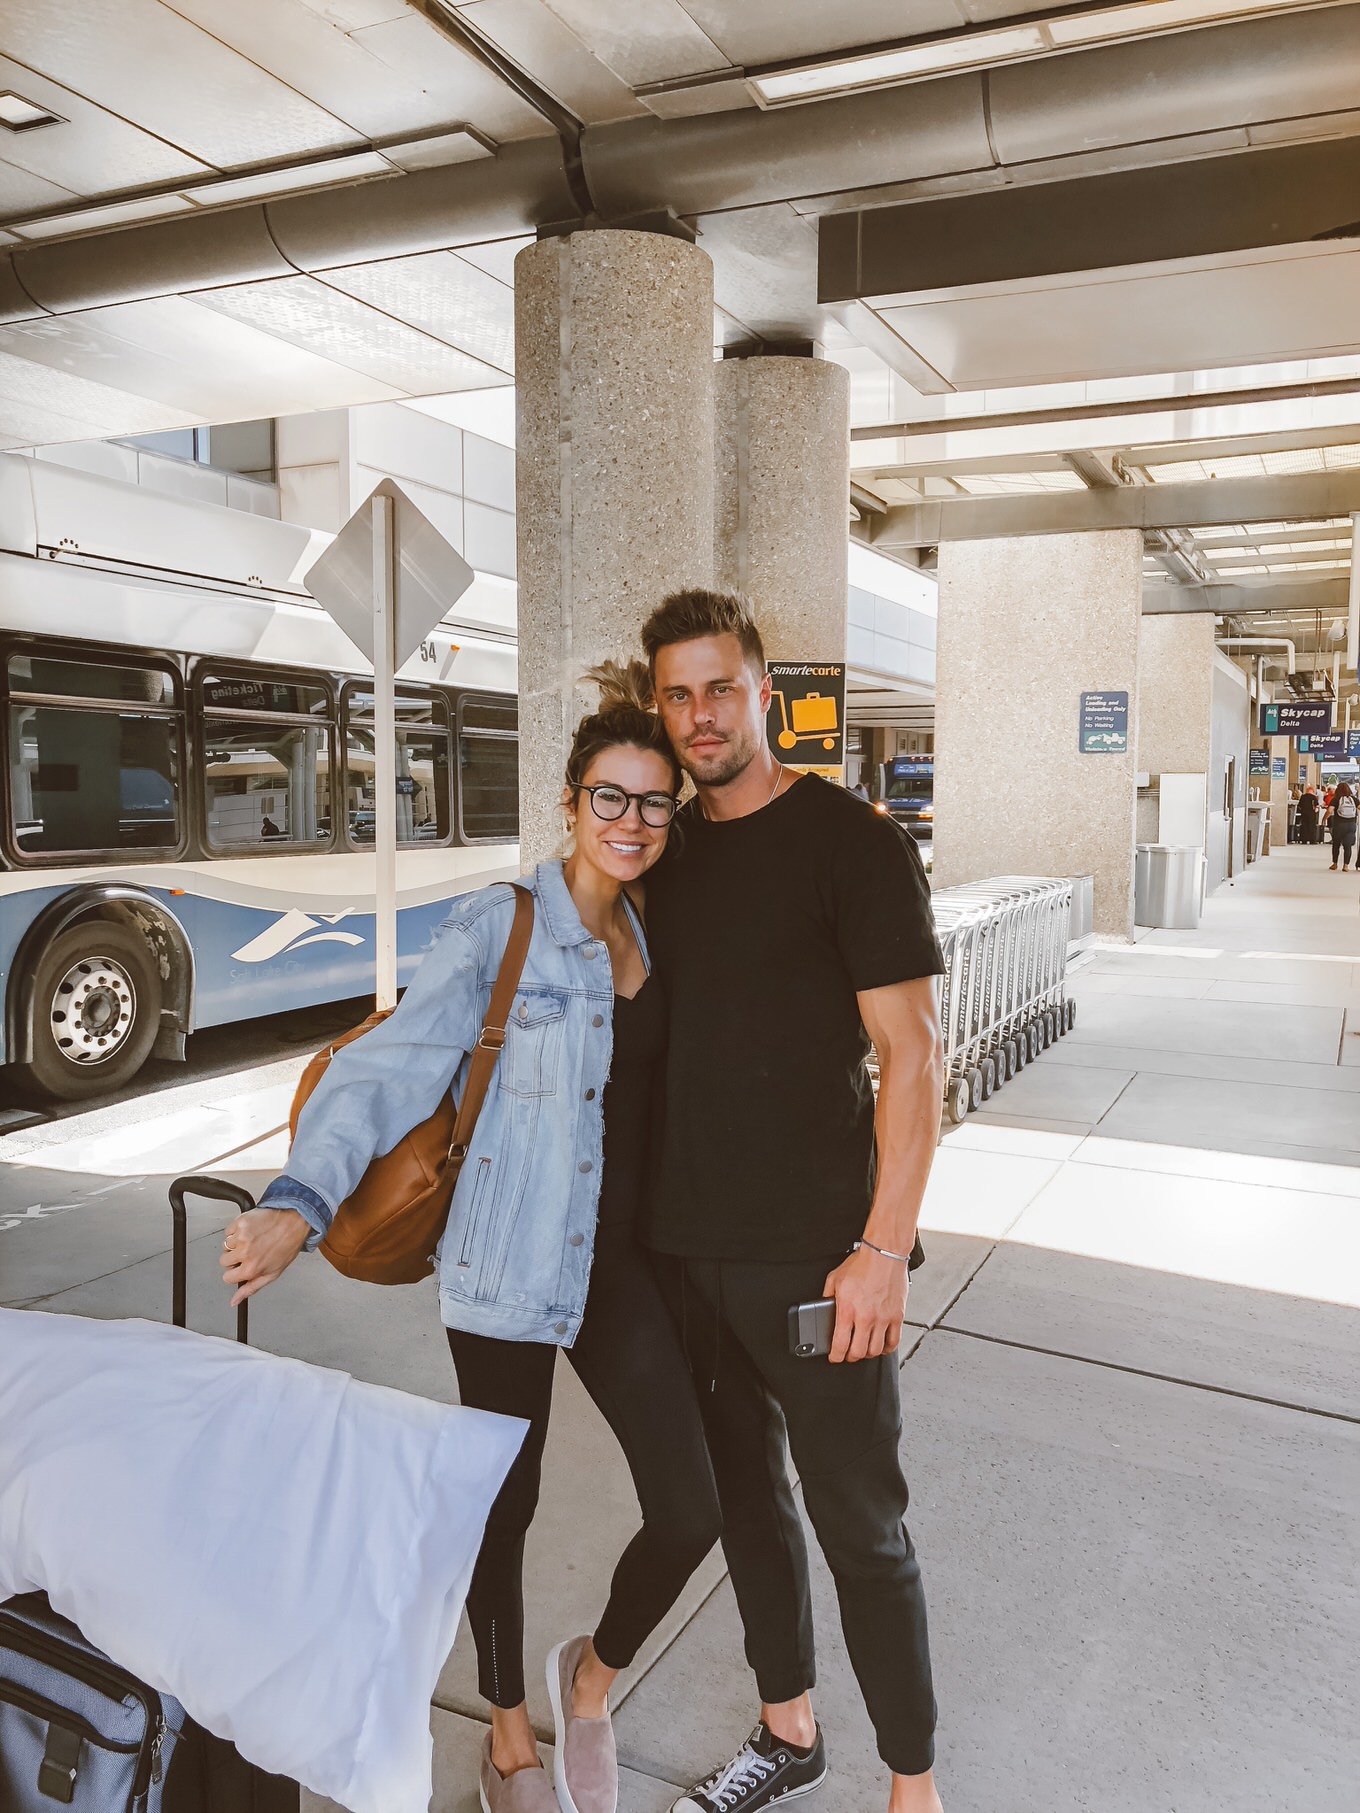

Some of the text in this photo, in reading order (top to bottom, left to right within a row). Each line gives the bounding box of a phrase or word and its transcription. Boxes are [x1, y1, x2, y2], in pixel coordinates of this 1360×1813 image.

[771, 665, 841, 676] smartecarte
[1280, 708, 1326, 718] Skycap
[941, 954, 952, 1040] smartecarte
[959, 947, 971, 1031] smartecarte
[973, 942, 983, 1022] smartecarte
[984, 936, 994, 1014] smartecarte
